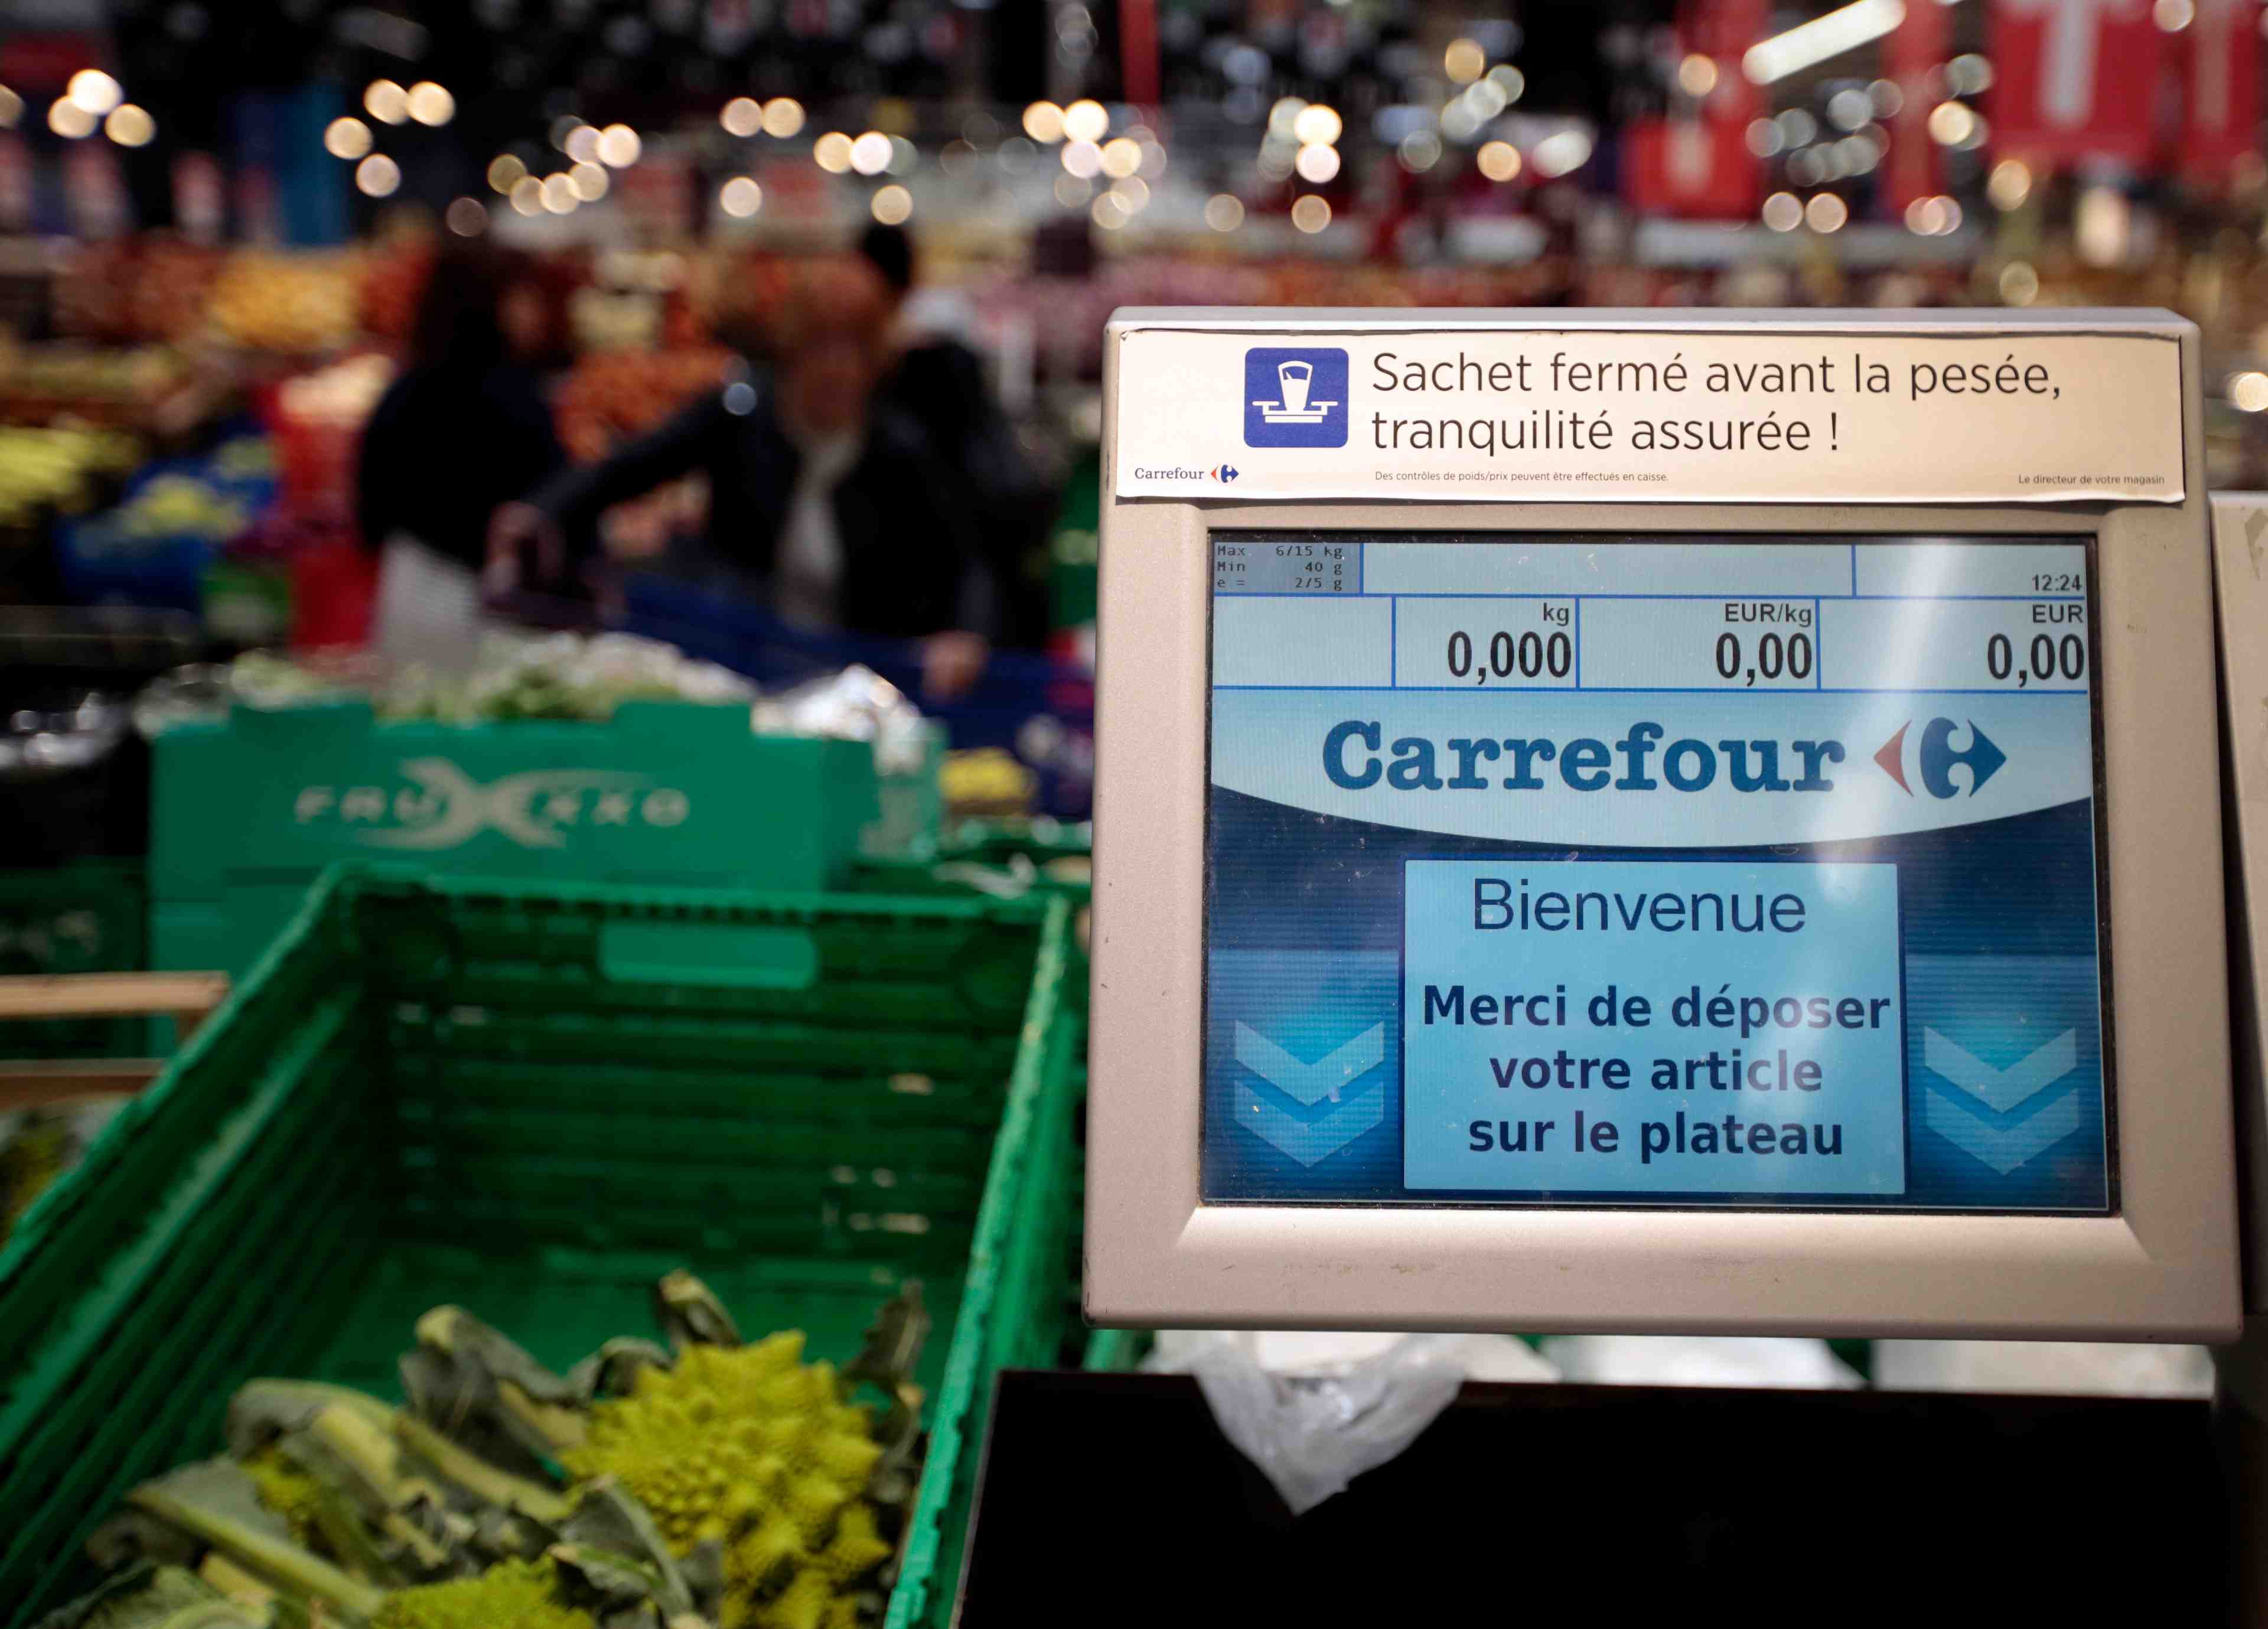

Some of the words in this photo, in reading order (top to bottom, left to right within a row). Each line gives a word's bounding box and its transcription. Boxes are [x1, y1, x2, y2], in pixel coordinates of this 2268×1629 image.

[1373, 352, 1531, 392] Sachet
[1550, 352, 1687, 392] fermé
[1706, 356, 1835, 393] avant
[1855, 353, 1890, 393] la
[1911, 354, 2060, 401] pesée,
[1371, 409, 1613, 457] tranquilité
[1631, 410, 1810, 451] assurée
[1831, 412, 1837, 451] !
[1134, 467, 1205, 480] Carrefour
[1375, 471, 1393, 480] Des
[1396, 471, 1441, 481] contrôles
[1443, 472, 1456, 481] de
[1458, 471, 1508, 483] poids/prix
[1511, 472, 1550, 482] peuvent
[1553, 472, 1572, 481] être
[1575, 471, 1620, 481] effectués
[2018, 474, 2031, 484] Le
[2033, 475, 2076, 484] directeur
[2080, 475, 2092, 484] de
[2095, 475, 2121, 484] votre
[2123, 475, 2165, 486] magasin
[1217, 545, 1245, 556] Max
[1276, 545, 1312, 556] 6/15
[1324, 546, 1342, 560] kg
[1217, 561, 1246, 572] Min
[1305, 562, 1324, 572] 40
[1334, 563, 1342, 575] g
[1217, 579, 1226, 588] e
[1295, 577, 1322, 588] 2/5
[1334, 579, 1342, 591] g
[2032, 574, 2083, 591] 12:24
[1543, 602, 1569, 627] kg
[1725, 603, 1811, 628] EUR/kg
[2032, 604, 2083, 623] EUR
[1448, 631, 1572, 686] 0,000
[1716, 632, 1812, 687] 0,00
[1987, 633, 2085, 688] 0,00
[1322, 720, 1845, 793] Carrefour
[1474, 878, 1806, 933] Bienvenue
[1424, 985, 1566, 1026] Merci
[1588, 985, 1651, 1027] de
[1671, 983, 1891, 1039] déposer
[1489, 1050, 1631, 1090] votre
[1651, 1048, 1822, 1091] article
[1469, 1120, 1555, 1152] sur
[1575, 1110, 1619, 1154] le
[1641, 1111, 1842, 1164] plateau
